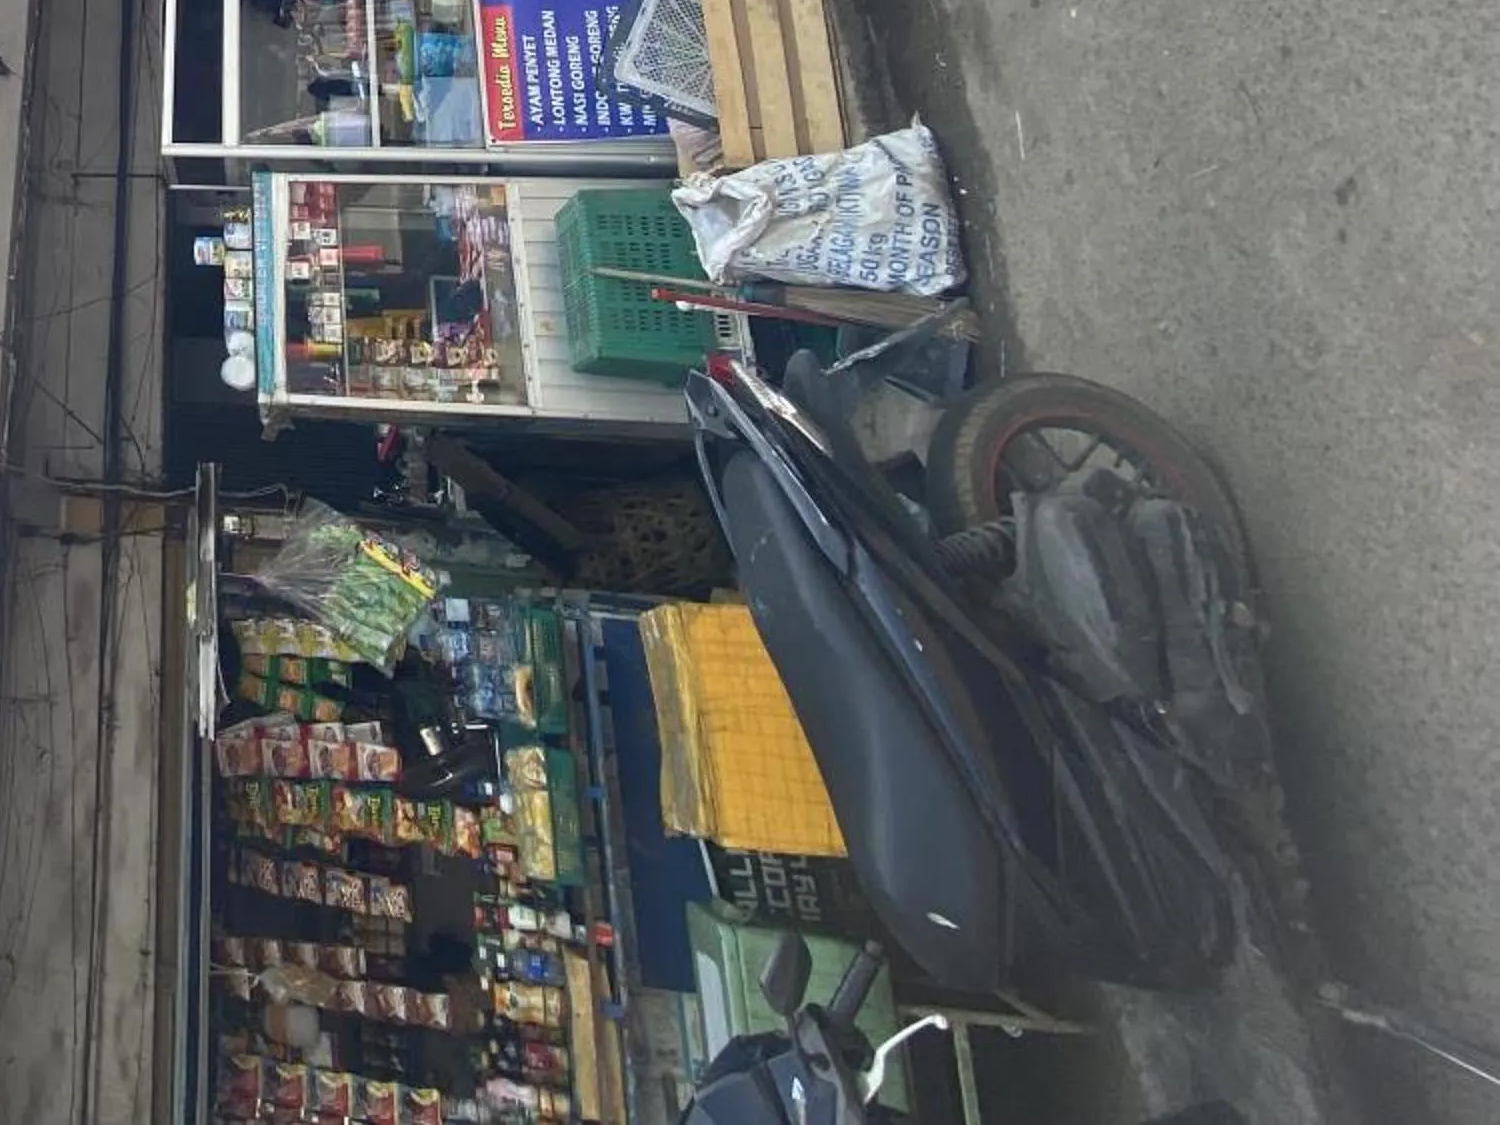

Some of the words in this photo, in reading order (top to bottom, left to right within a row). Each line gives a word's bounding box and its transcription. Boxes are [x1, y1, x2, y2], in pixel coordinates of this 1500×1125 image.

[489, 16, 510, 58] Menu
[541, 10, 562, 58] MEDAN
[522, 34, 540, 83] PENYET
[566, 35, 585, 90] GORENG
[495, 64, 518, 130] Tersedia
[527, 84, 546, 125] AYAM
[546, 58, 567, 125] LONTONG
[572, 92, 589, 125] NASI
[895, 190, 915, 217] OF
[862, 233, 888, 256] kg
[886, 222, 913, 285] MONTH
[911, 201, 942, 287] SEASON
[859, 258, 880, 282] 50
